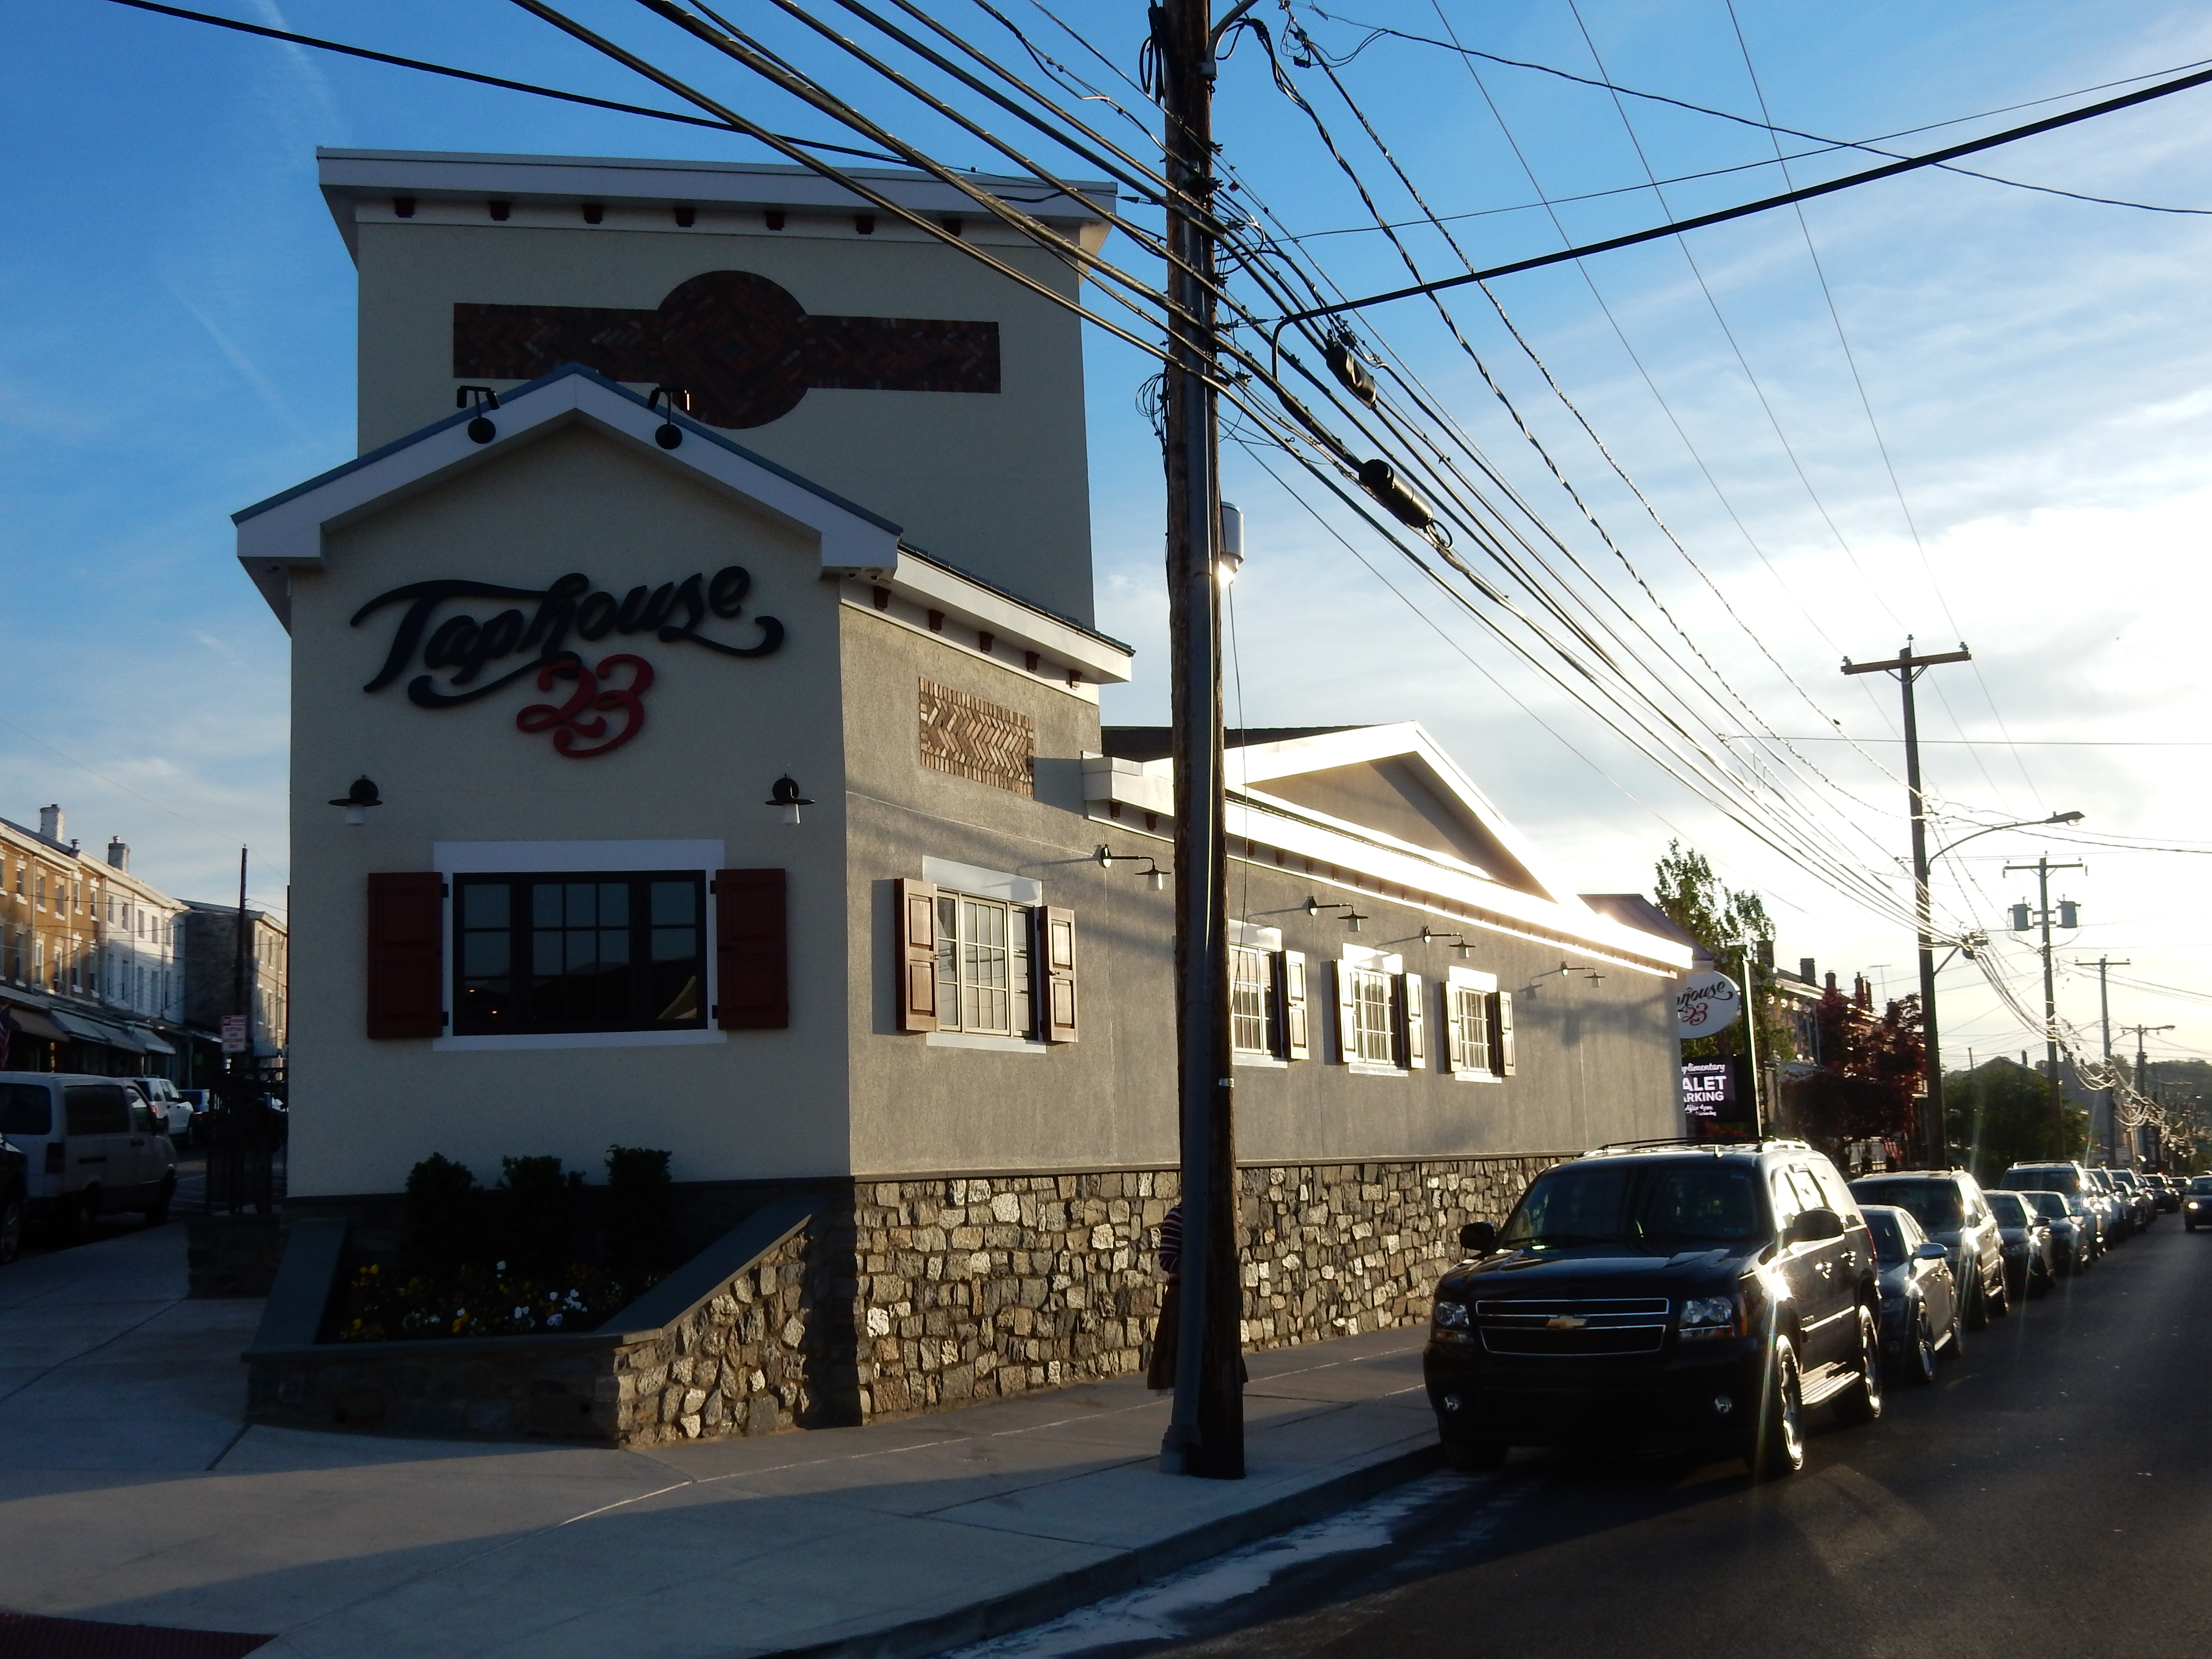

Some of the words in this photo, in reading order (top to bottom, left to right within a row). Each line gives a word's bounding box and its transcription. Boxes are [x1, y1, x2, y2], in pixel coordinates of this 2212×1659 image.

[350, 565, 785, 709] Taphouse
[516, 653, 655, 758] 23
[1677, 981, 1733, 1009] house
[1681, 1002, 1708, 1026] 23
[1681, 1062, 1726, 1075] plimentary
[1682, 1076, 1727, 1092] ALET
[1683, 1091, 1724, 1103] RKING
